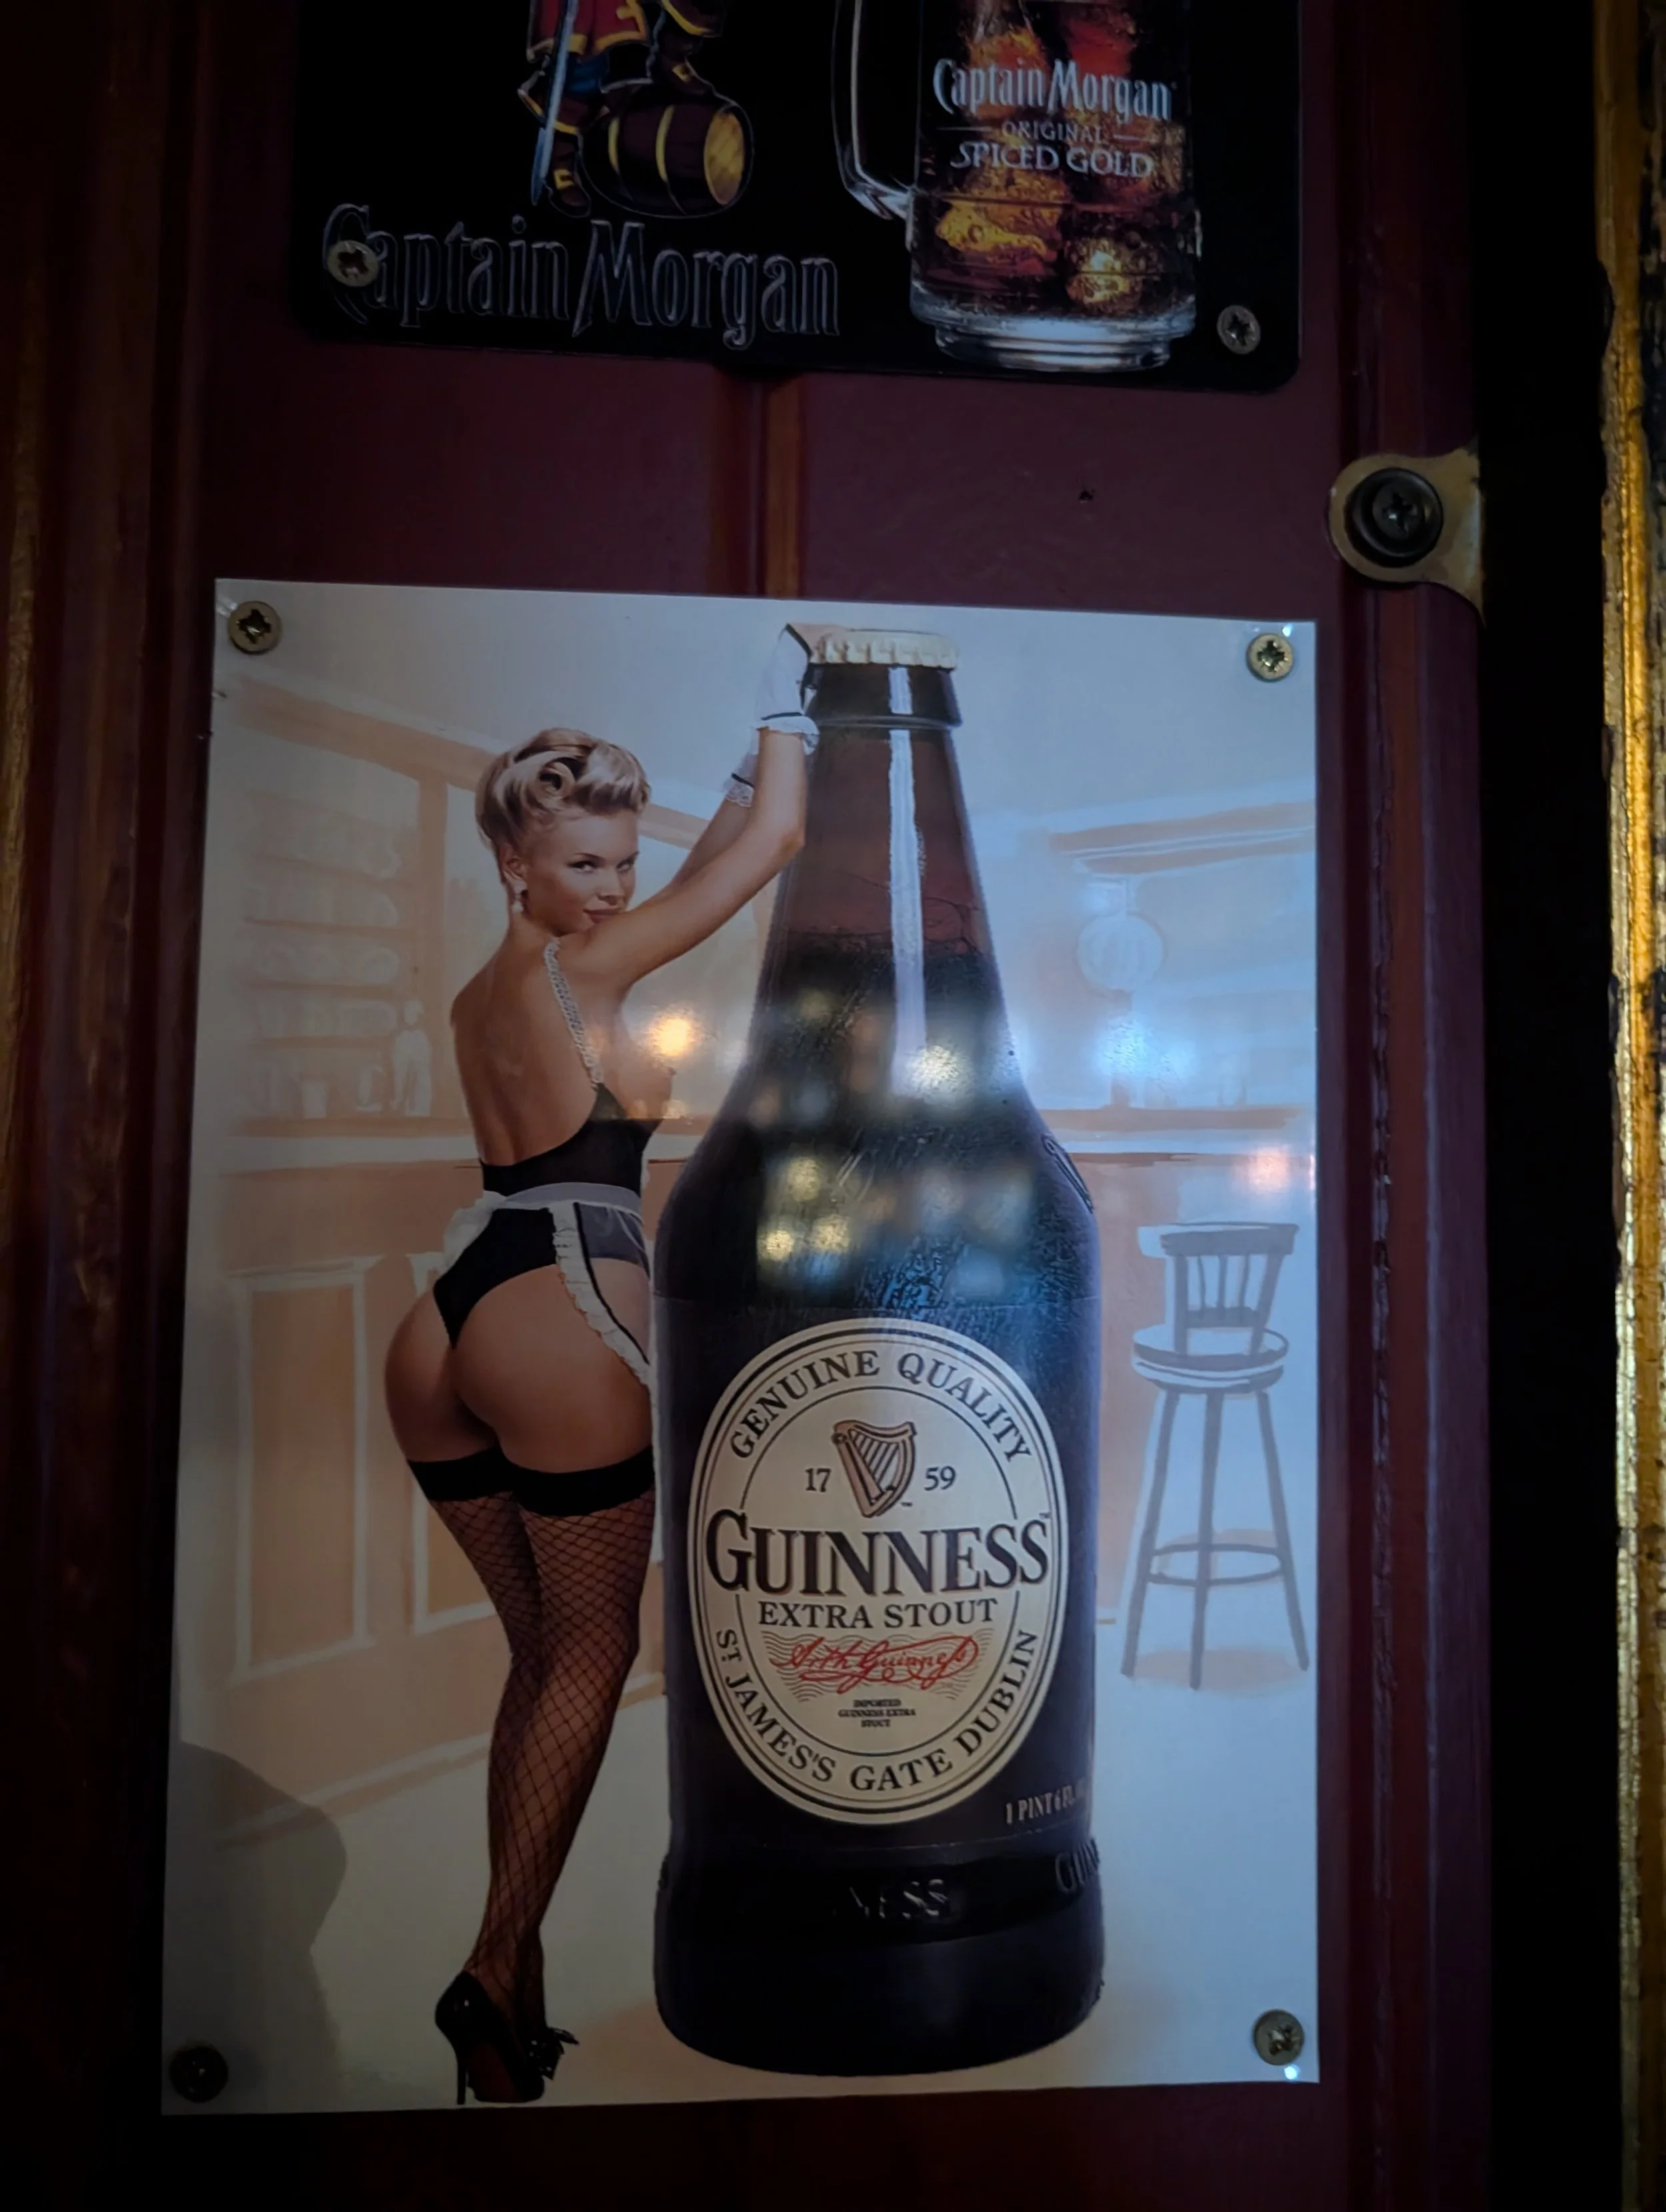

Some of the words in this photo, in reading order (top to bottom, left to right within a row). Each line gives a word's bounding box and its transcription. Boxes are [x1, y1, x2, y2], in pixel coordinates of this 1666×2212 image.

[934, 57, 1046, 117] Captain
[1046, 58, 1173, 125] Morgan
[950, 140, 1061, 171] SPICED
[1066, 146, 1154, 178] GOLD
[1002, 120, 1108, 145] ORIGINAL
[571, 219, 841, 350] Morgan
[730, 1350, 880, 1458] GENUINE
[897, 1352, 1032, 1462] QUALITY
[705, 1508, 1050, 1596] GUINNESS
[758, 1600, 874, 1629] EXTRA
[884, 1598, 999, 1628] STOUT
[850, 1748, 954, 1792] GATE
[953, 1630, 1040, 1756] DUBLIN
